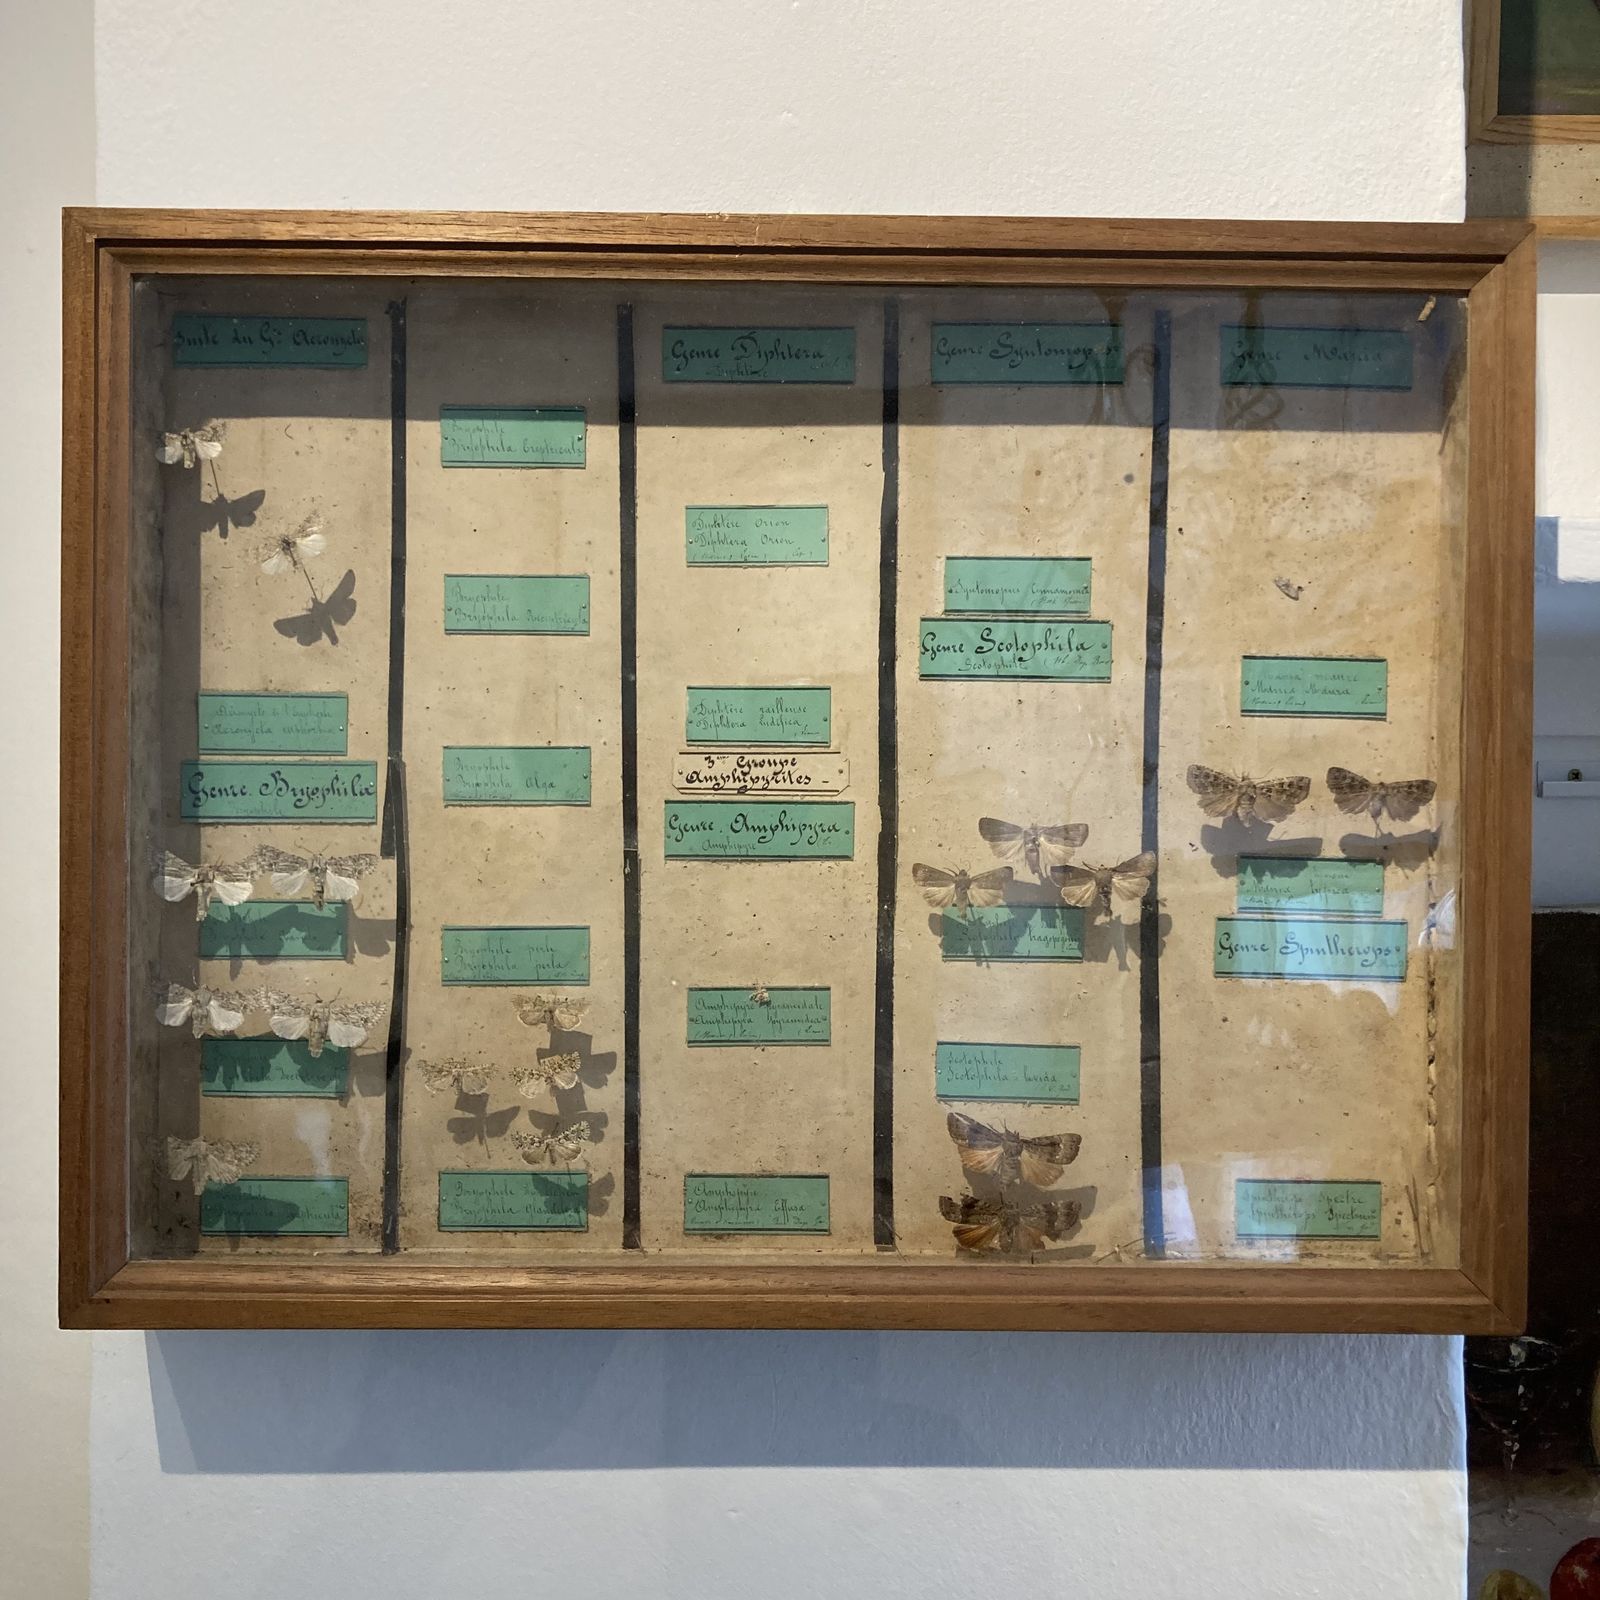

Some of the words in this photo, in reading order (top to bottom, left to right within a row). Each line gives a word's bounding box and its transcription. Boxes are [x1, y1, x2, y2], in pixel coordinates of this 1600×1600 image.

[671, 339, 720, 371] Genre
[937, 337, 983, 364] Genre
[921, 632, 965, 661] Genre
[975, 627, 1096, 662] Scotophila
[736, 756, 797, 777] Groupe
[260, 770, 375, 809] Bryophila
[669, 814, 715, 842] Genre
[730, 810, 841, 845] Amphipyra
[1217, 932, 1270, 959] Genre
